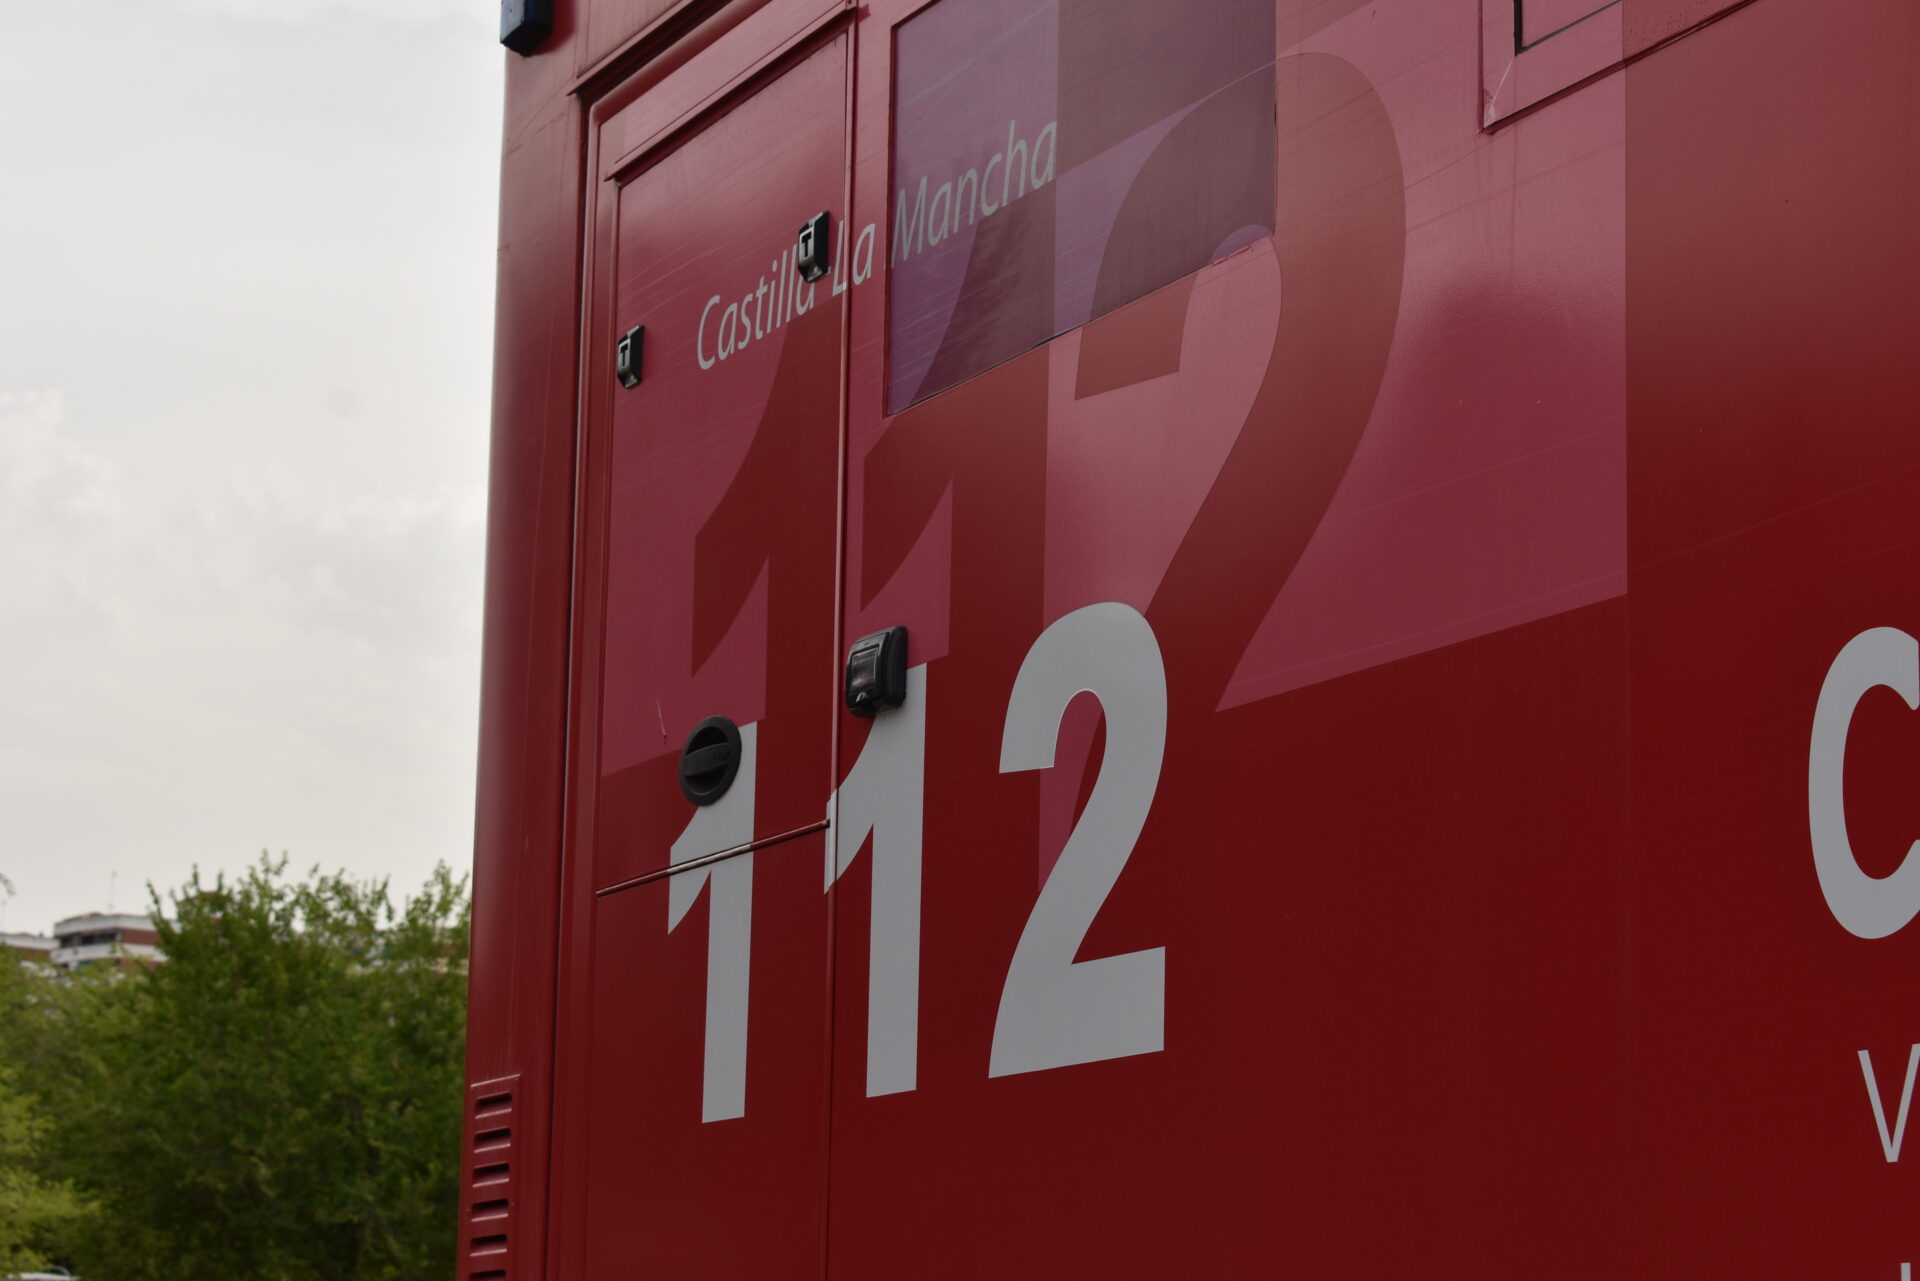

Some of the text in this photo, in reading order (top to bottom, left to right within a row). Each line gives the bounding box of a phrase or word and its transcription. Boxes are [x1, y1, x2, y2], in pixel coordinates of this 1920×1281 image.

[832, 219, 876, 296] La
[884, 119, 1058, 269] Mancha
[667, 601, 1168, 1124] 112
